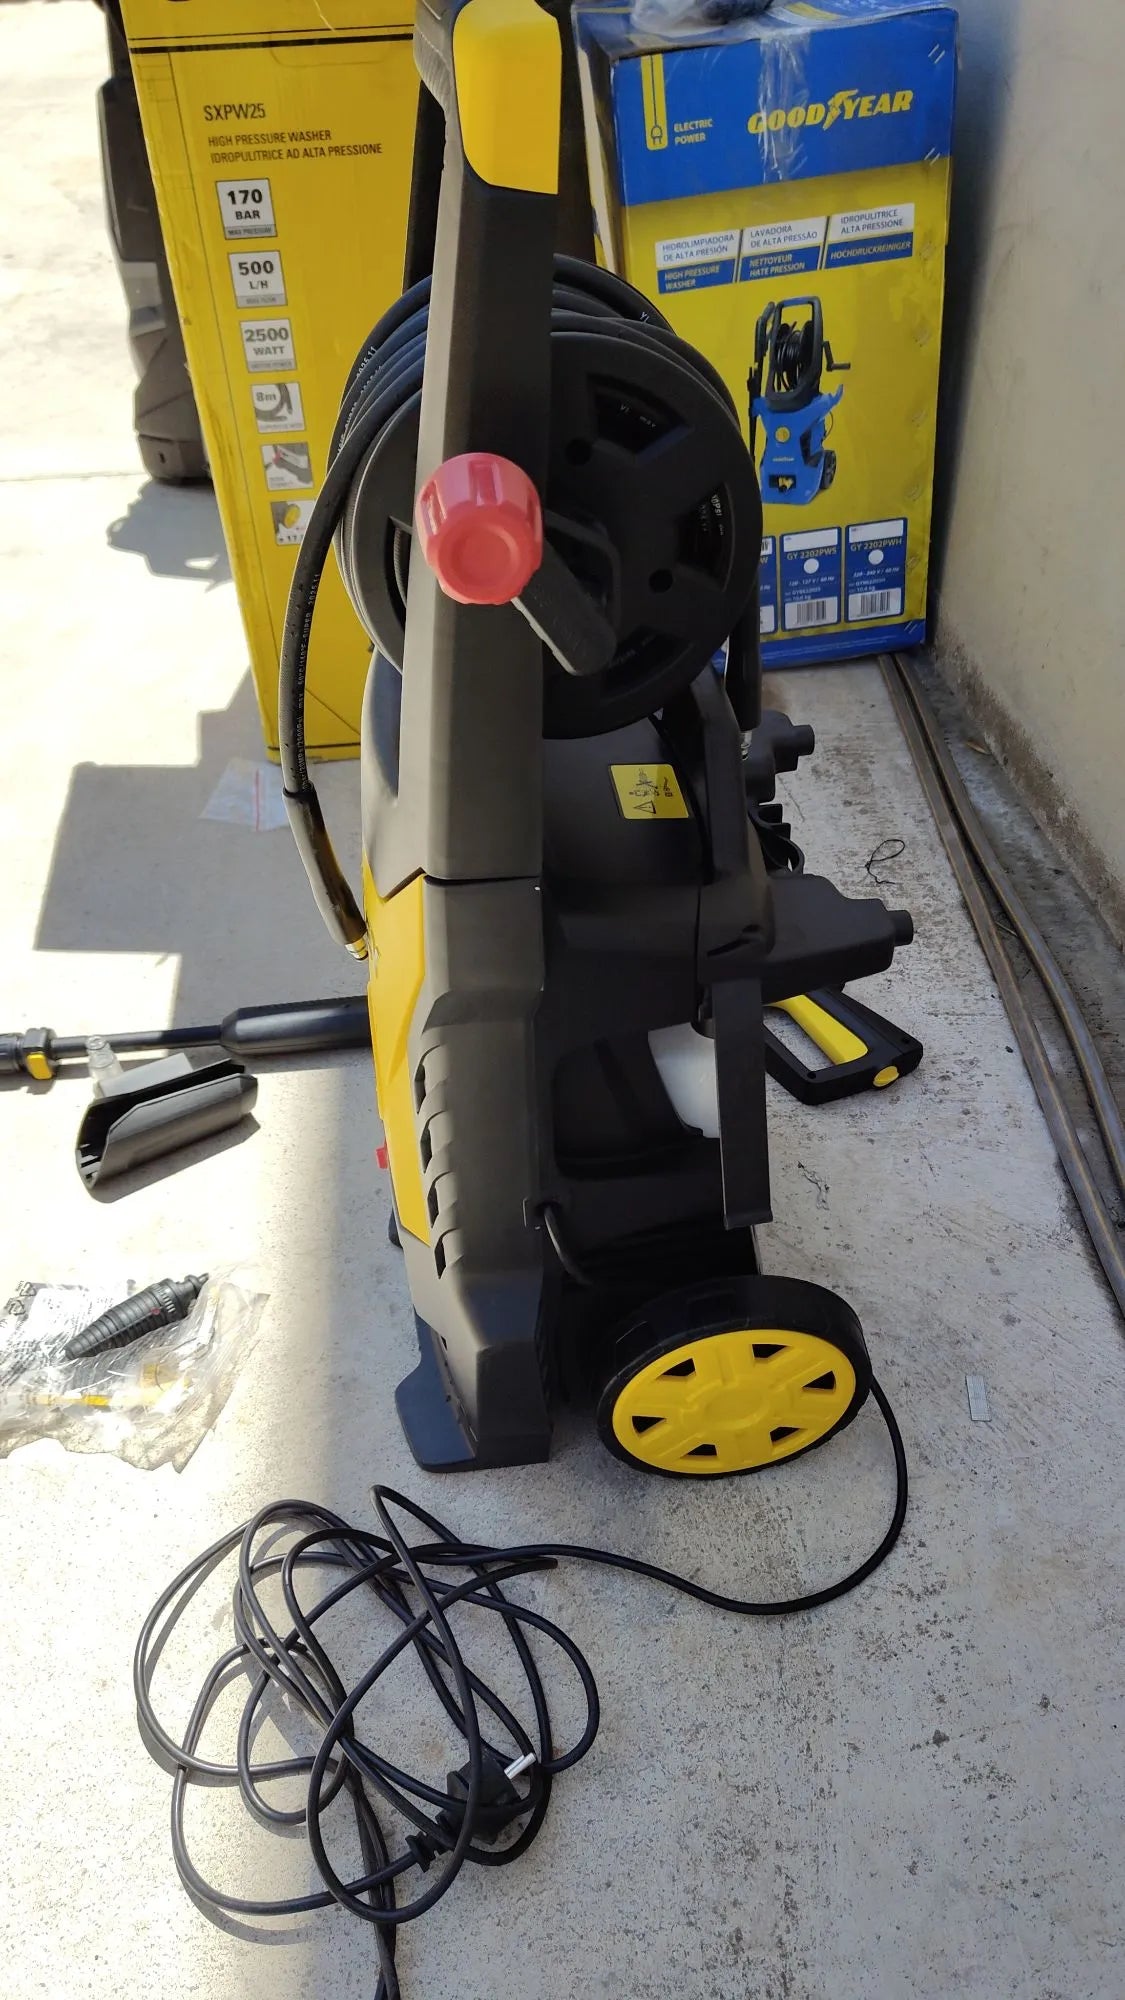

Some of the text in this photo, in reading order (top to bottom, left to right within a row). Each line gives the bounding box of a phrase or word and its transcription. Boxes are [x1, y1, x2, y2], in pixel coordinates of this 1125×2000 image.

[204, 103, 266, 121] SXPW25
[747, 89, 914, 134] GOODYEAR
[674, 118, 713, 132] ELECTRIC
[208, 129, 332, 147] HIGH PRESSURE WASHER
[674, 132, 707, 145] POWER
[211, 143, 383, 164] IDROPULITRICE AD ALTA PRESSIONE
[227, 188, 263, 205] 170
[235, 210, 261, 220] BAR
[841, 208, 898, 223] IDROPULITRICE
[750, 224, 792, 238] LAVADORA
[841, 218, 903, 235] ALTA PRESSIONE
[662, 233, 734, 251] HIDROLIMPIADORA
[750, 231, 818, 248] DE ALTA PRESSÃO
[663, 244, 728, 262] DE ALTA PRESIÓN
[830, 241, 911, 260] HOCHDRUCKREINIGER
[238, 260, 274, 275] 500
[750, 253, 792, 267] NETTOYEUR
[665, 265, 720, 281] HIGH PRESSURE
[770, 262, 805, 276] PRESSION
[665, 279, 696, 291] WASHER
[244, 327, 289, 342] 2500
[253, 346, 285, 356] WATT
[255, 391, 277, 403] 8m
[850, 538, 902, 552] GY 2202PWH
[786, 547, 837, 561] GY 2202PWS
